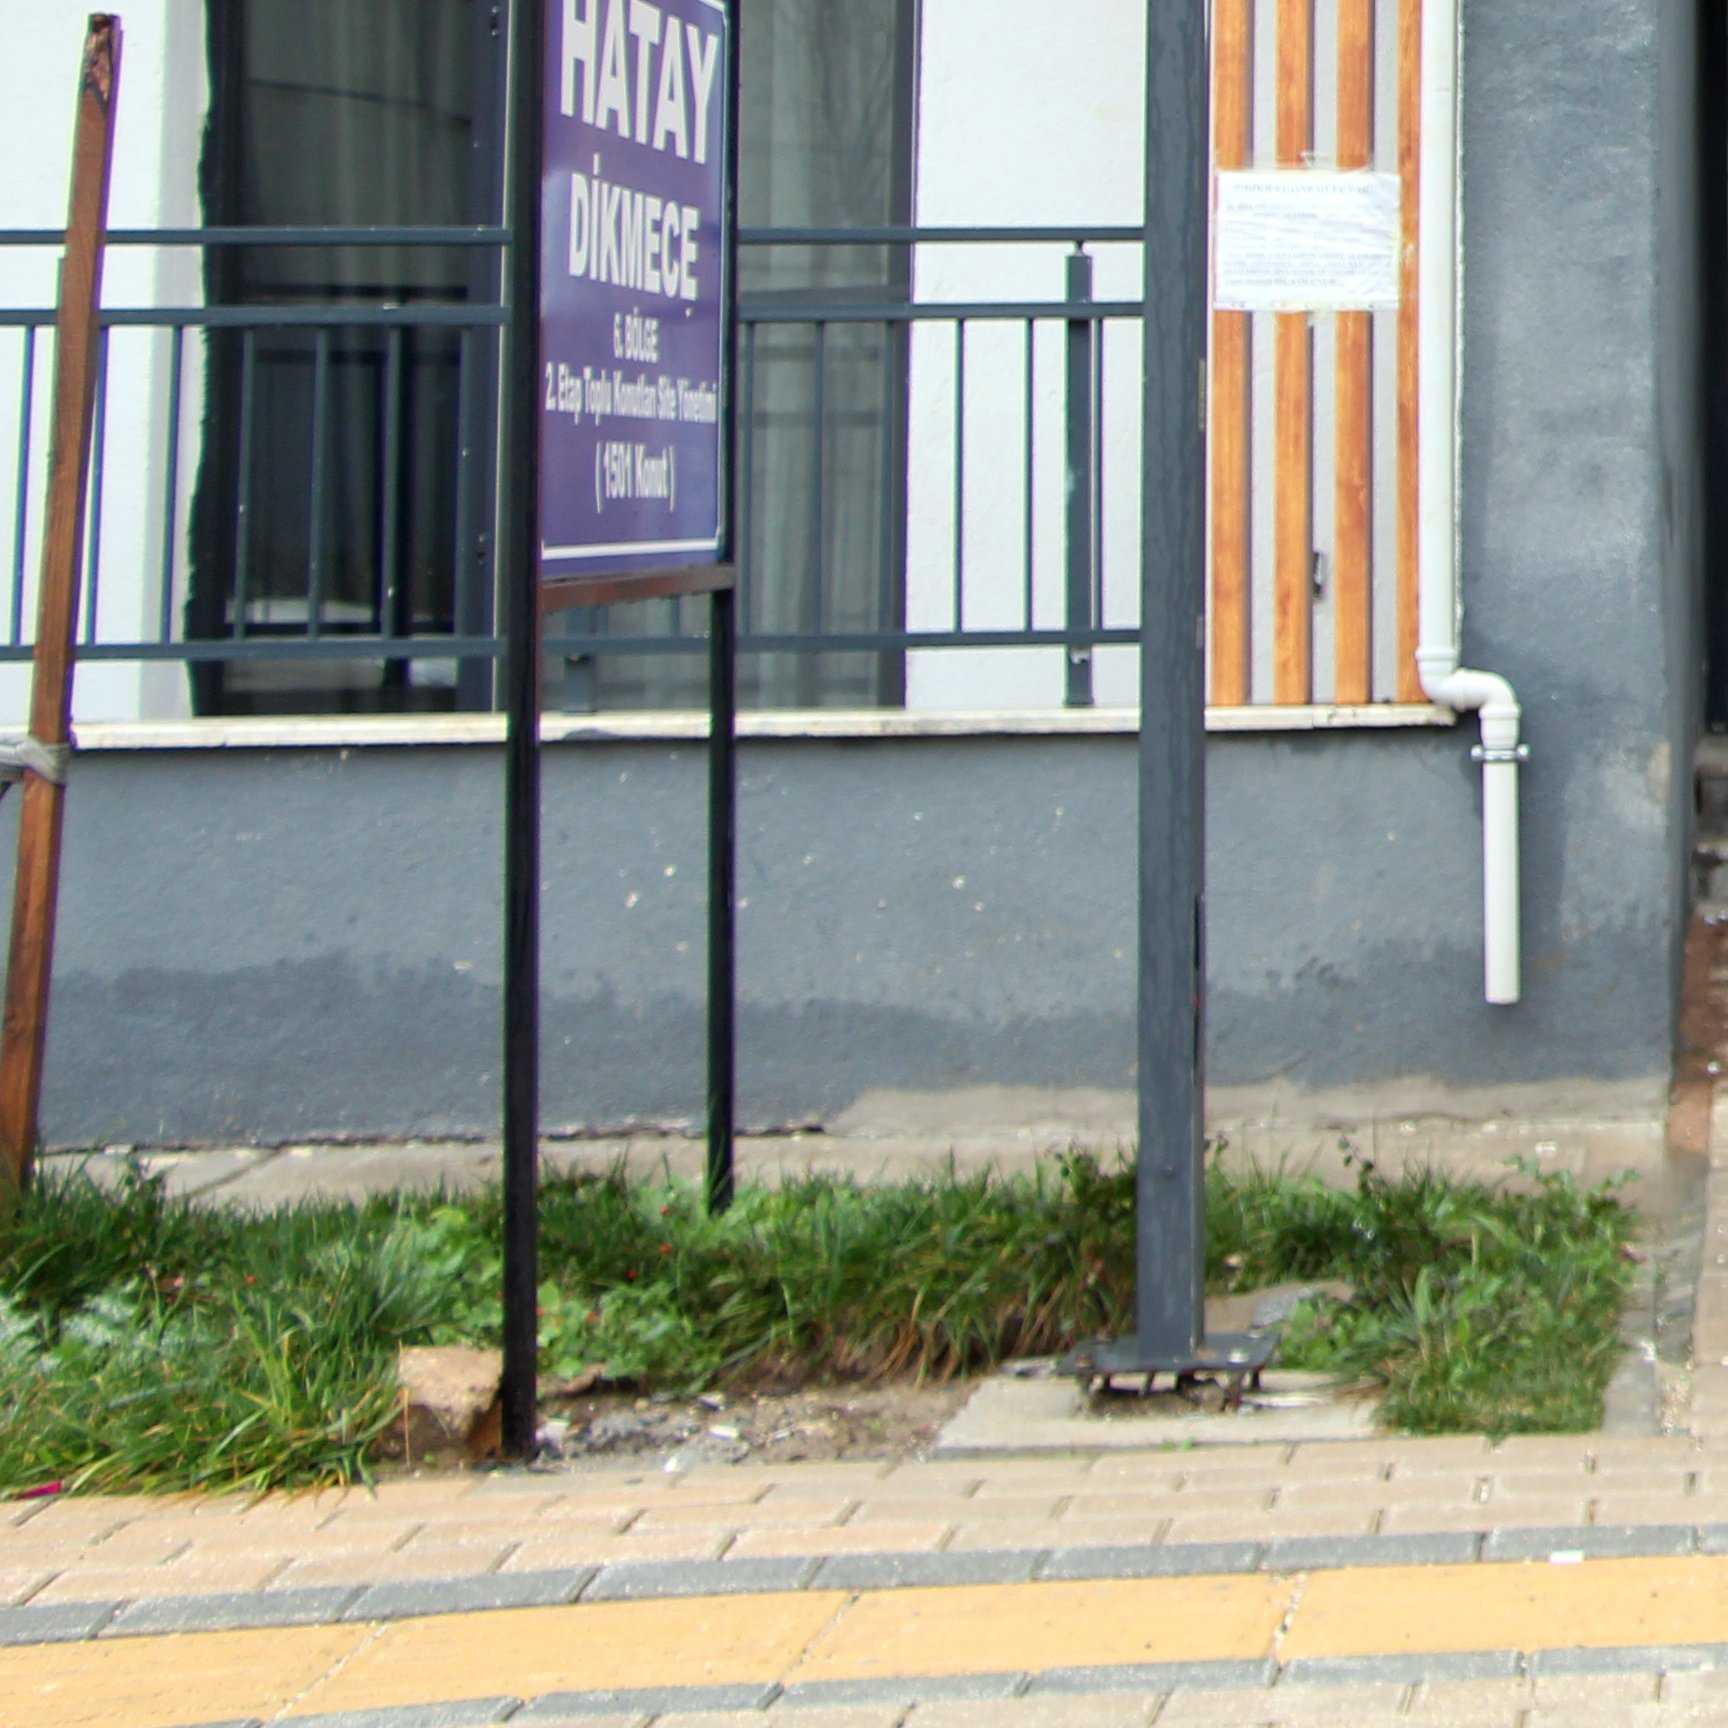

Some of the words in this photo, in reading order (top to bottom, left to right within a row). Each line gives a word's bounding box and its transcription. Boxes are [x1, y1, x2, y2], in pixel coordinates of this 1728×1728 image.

[568, 152, 700, 302] DİKMECE
[625, 306, 660, 364] BÖLGE
[545, 362, 556, 411] 2.
[558, 362, 582, 426] Etap
[583, 365, 612, 427] Toplu
[658, 375, 677, 422] Site
[677, 377, 718, 425] Yönetimi
